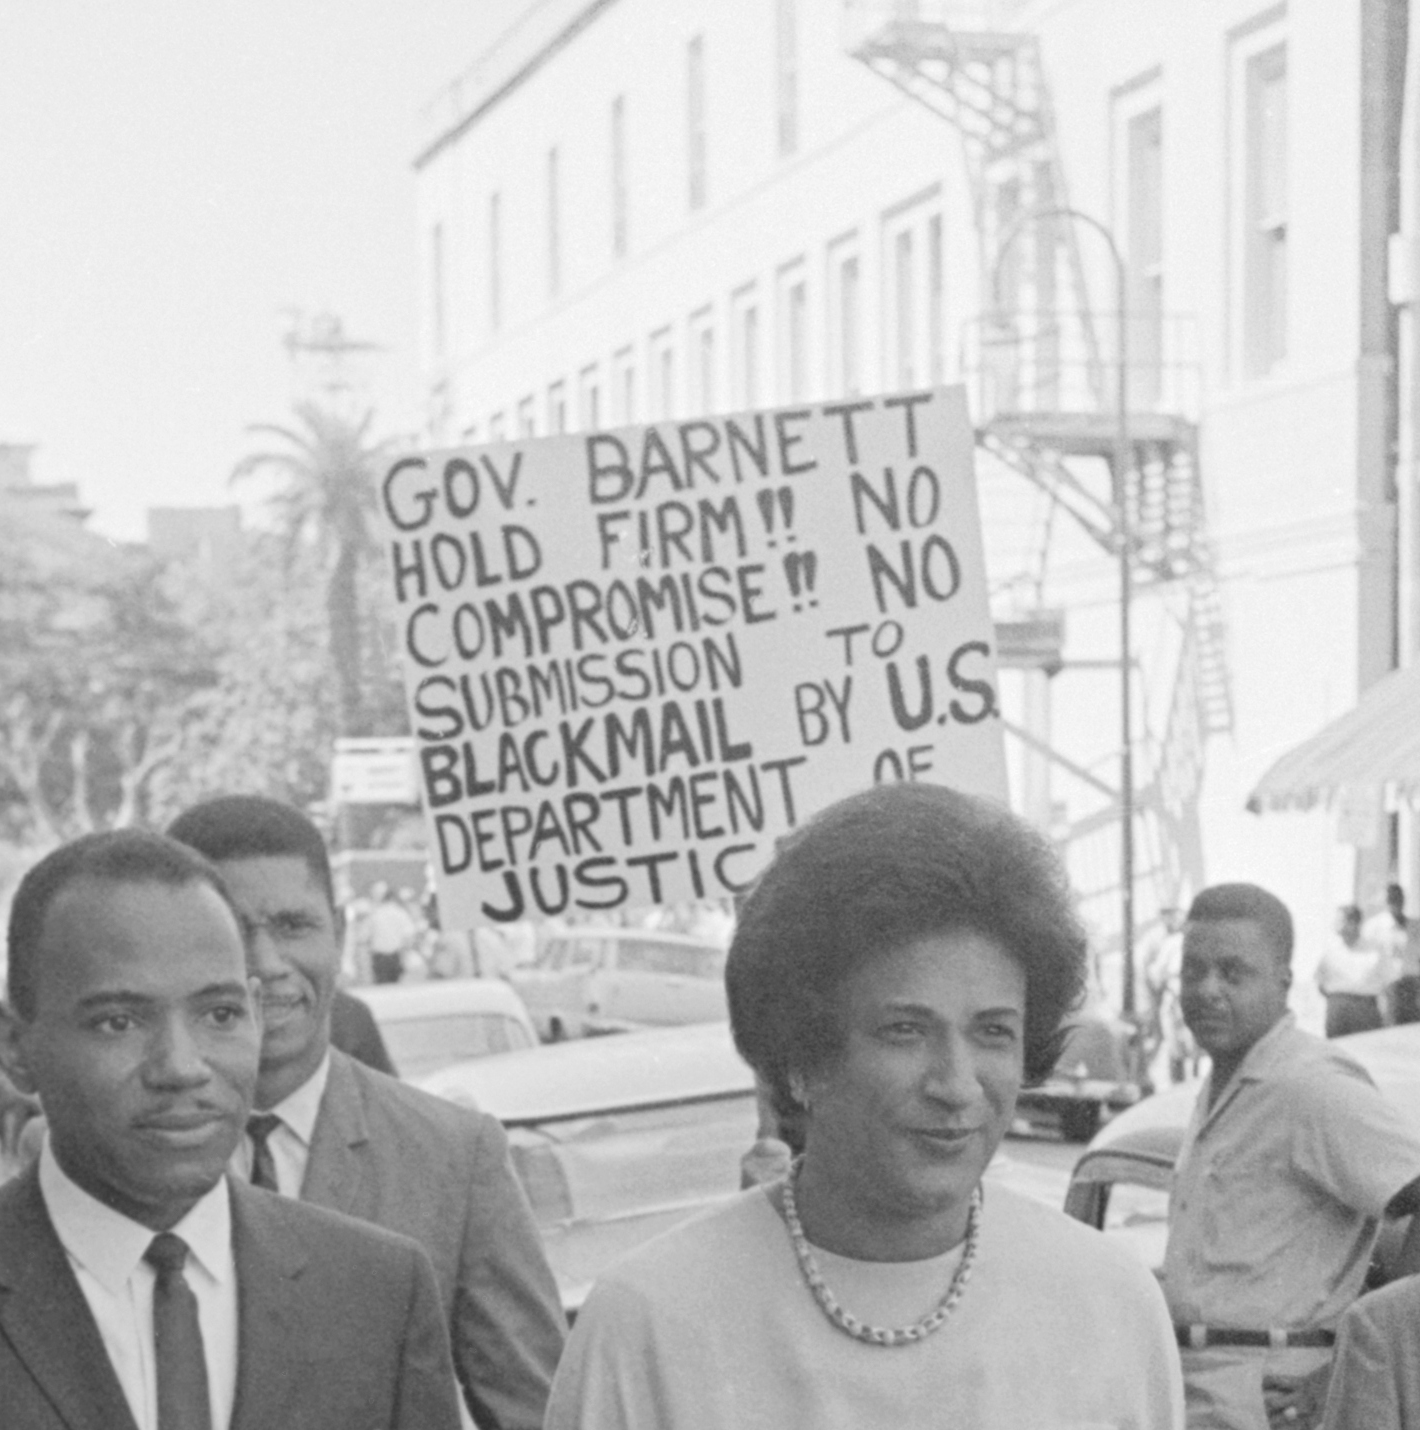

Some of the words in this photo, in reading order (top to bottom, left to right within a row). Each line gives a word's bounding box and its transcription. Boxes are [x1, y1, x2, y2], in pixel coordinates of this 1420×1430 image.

[383, 453, 536, 532] GOV.
[586, 394, 932, 505] BARNETT
[392, 525, 542, 602] HOLD
[851, 466, 940, 535] NO
[866, 535, 960, 613] NO
[415, 633, 742, 742] SUBMISSION
[826, 621, 904, 665] TO
[420, 698, 753, 808] BLACKMAIL
[794, 675, 852, 746] BY
[886, 641, 1001, 731] U.S.
[435, 756, 807, 875] DEPARTMENT
[481, 844, 759, 923] JUSTIC
